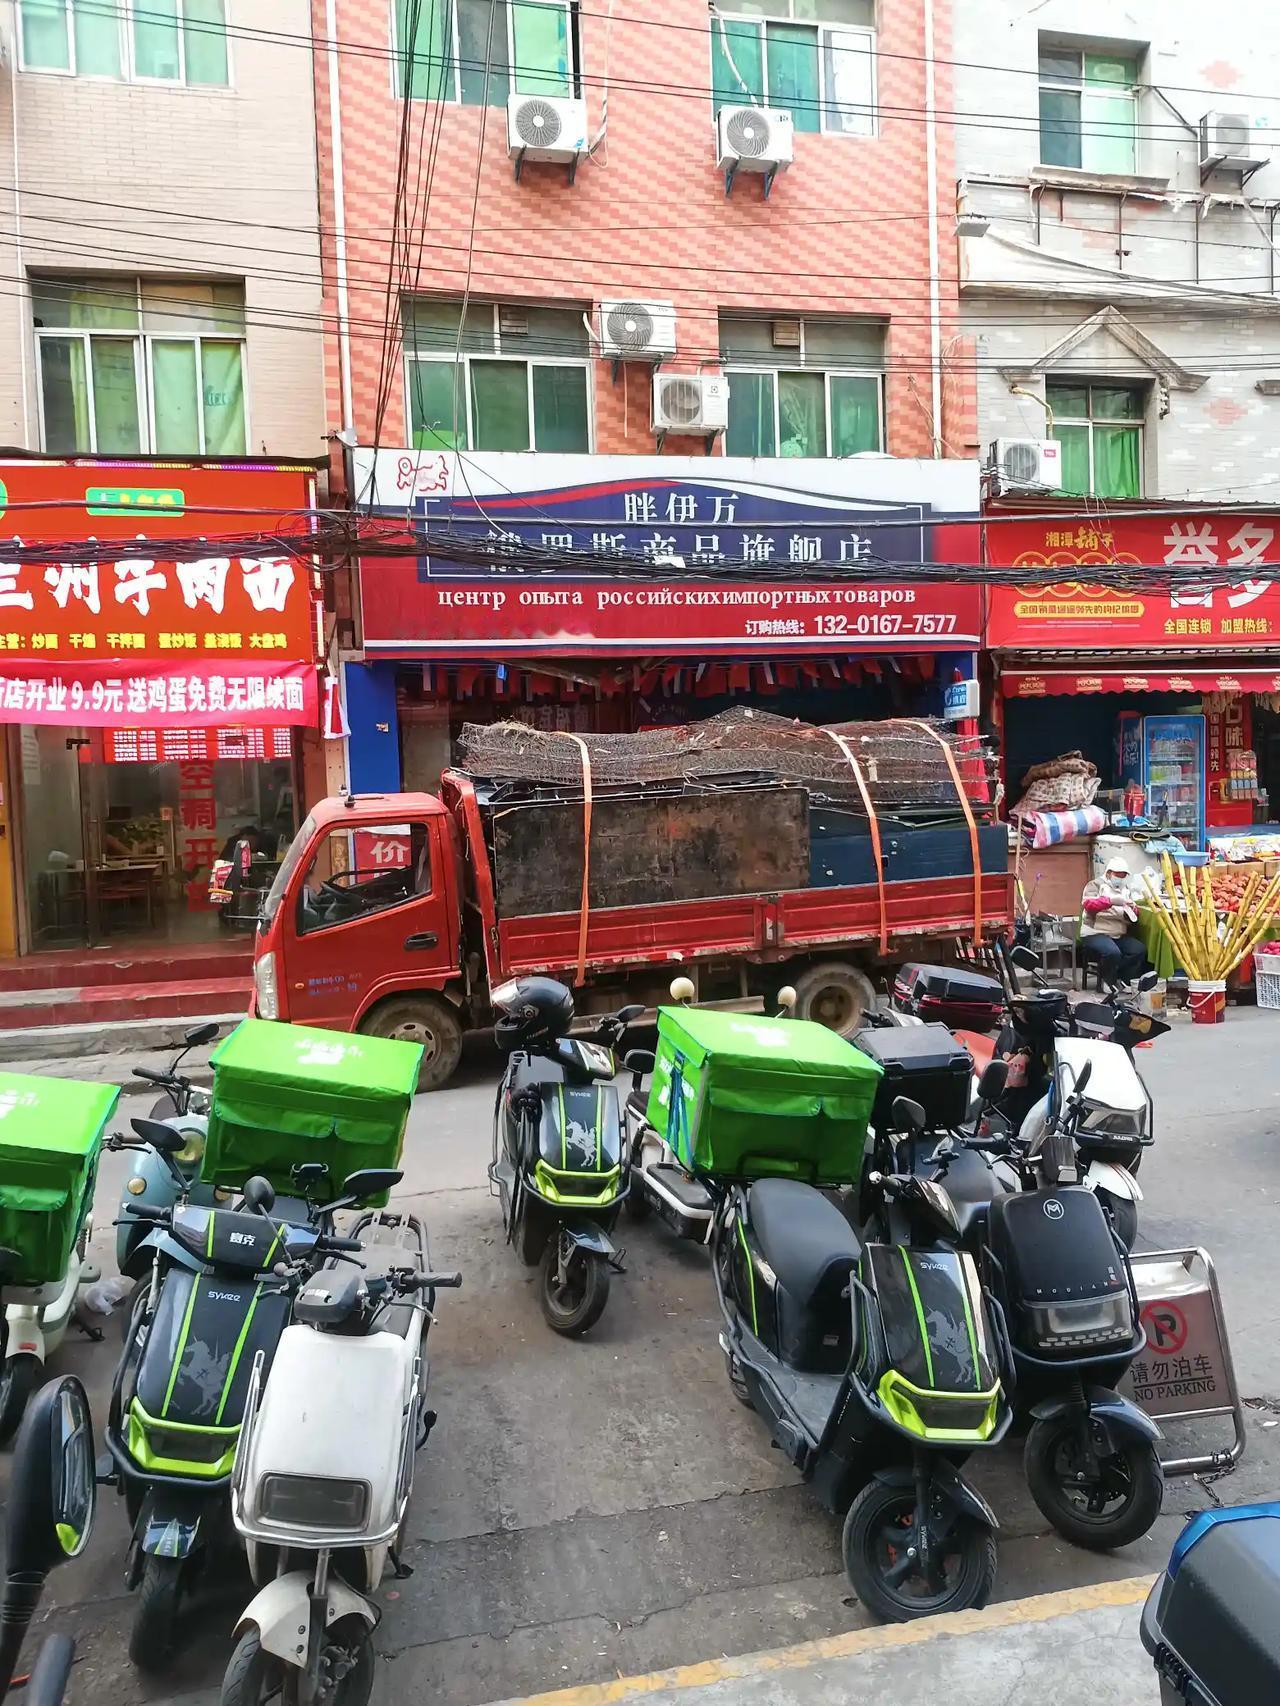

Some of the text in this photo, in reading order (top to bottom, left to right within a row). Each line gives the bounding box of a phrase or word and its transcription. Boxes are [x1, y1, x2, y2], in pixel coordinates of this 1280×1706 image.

[624, 492, 739, 524] 胖伊万
[438, 590, 506, 610] центр
[519, 591, 583, 605] опыта
[814, 614, 957, 634] 132-0167-7577
[1164, 618, 1273, 634] 全国连锁 加盟热线：
[0, 675, 304, 713] 店开业9.9元送鸡蛋免费无限续面
[1130, 1353, 1213, 1383] 请勿泊车
[1134, 1380, 1217, 1402] NO PARKING
